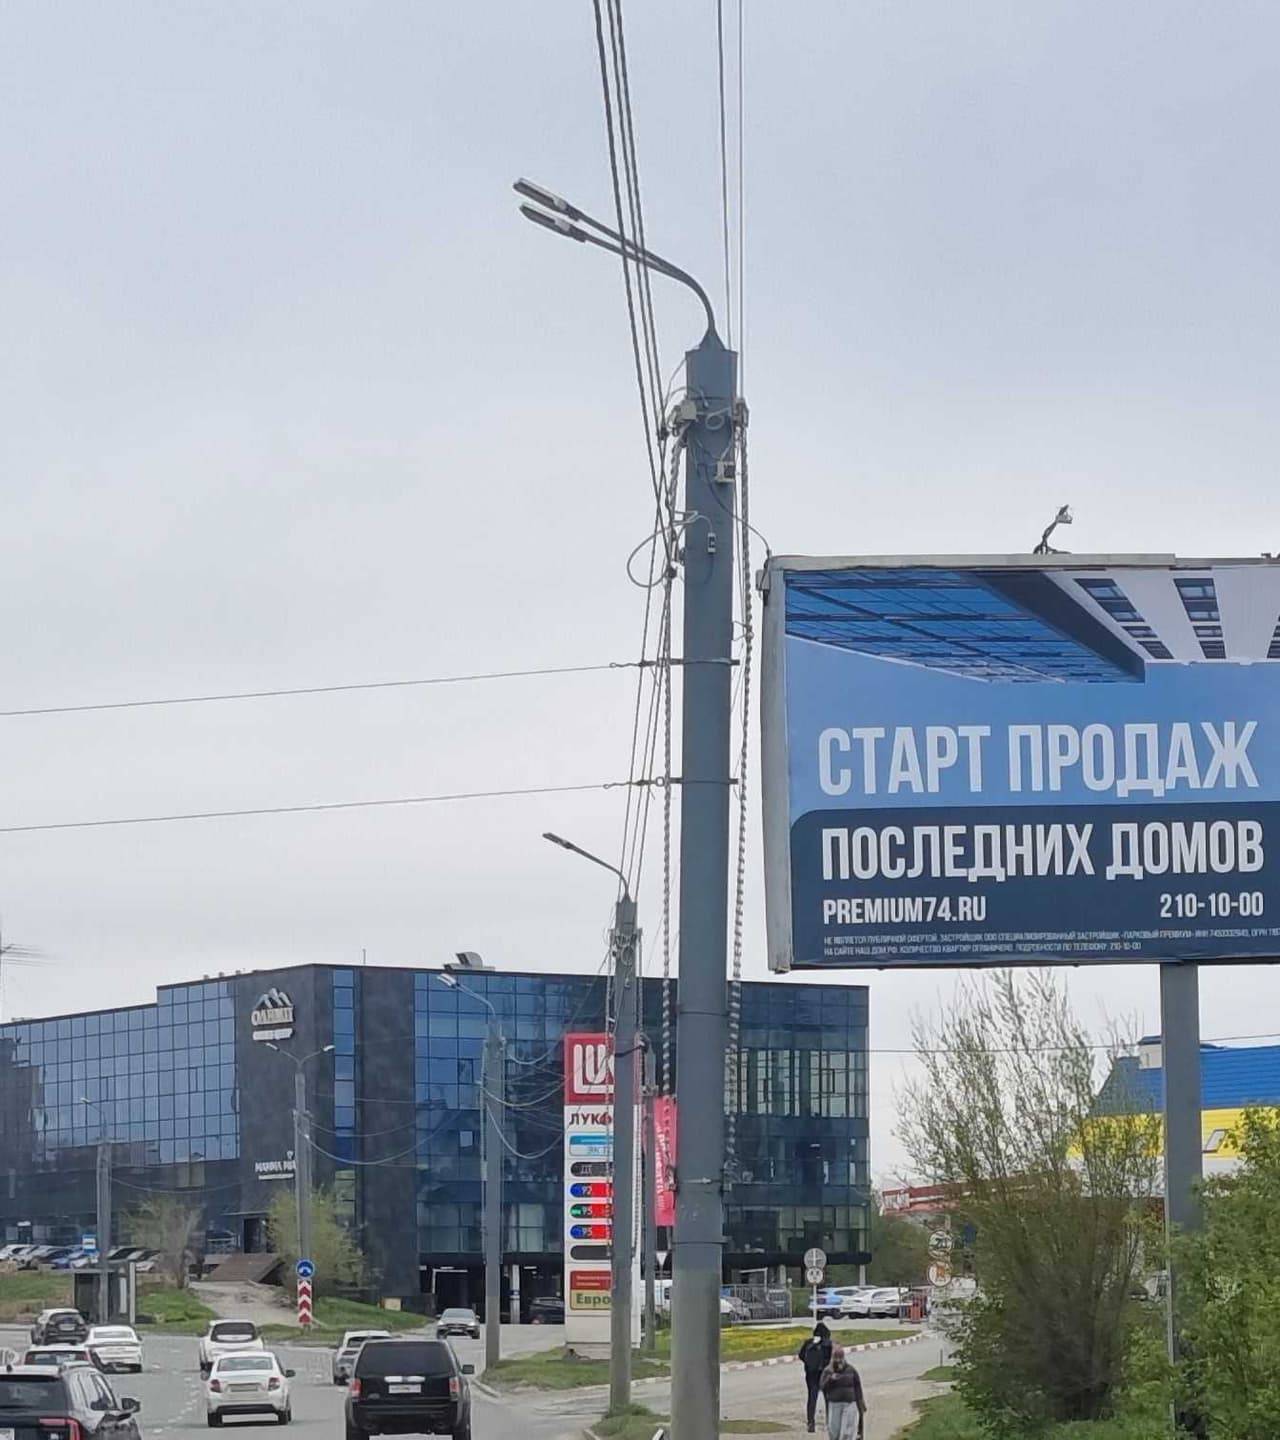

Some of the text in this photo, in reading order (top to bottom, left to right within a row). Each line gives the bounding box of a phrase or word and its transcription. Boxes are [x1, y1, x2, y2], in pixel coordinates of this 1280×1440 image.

[819, 721, 1260, 797] СТАРТ ПРОДАЖ
[822, 820, 1264, 882] ПОСЛЕДНИХ ДОМОВ
[823, 895, 986, 924] PREMIUM74.RU
[1160, 891, 1264, 917] 210-10-00
